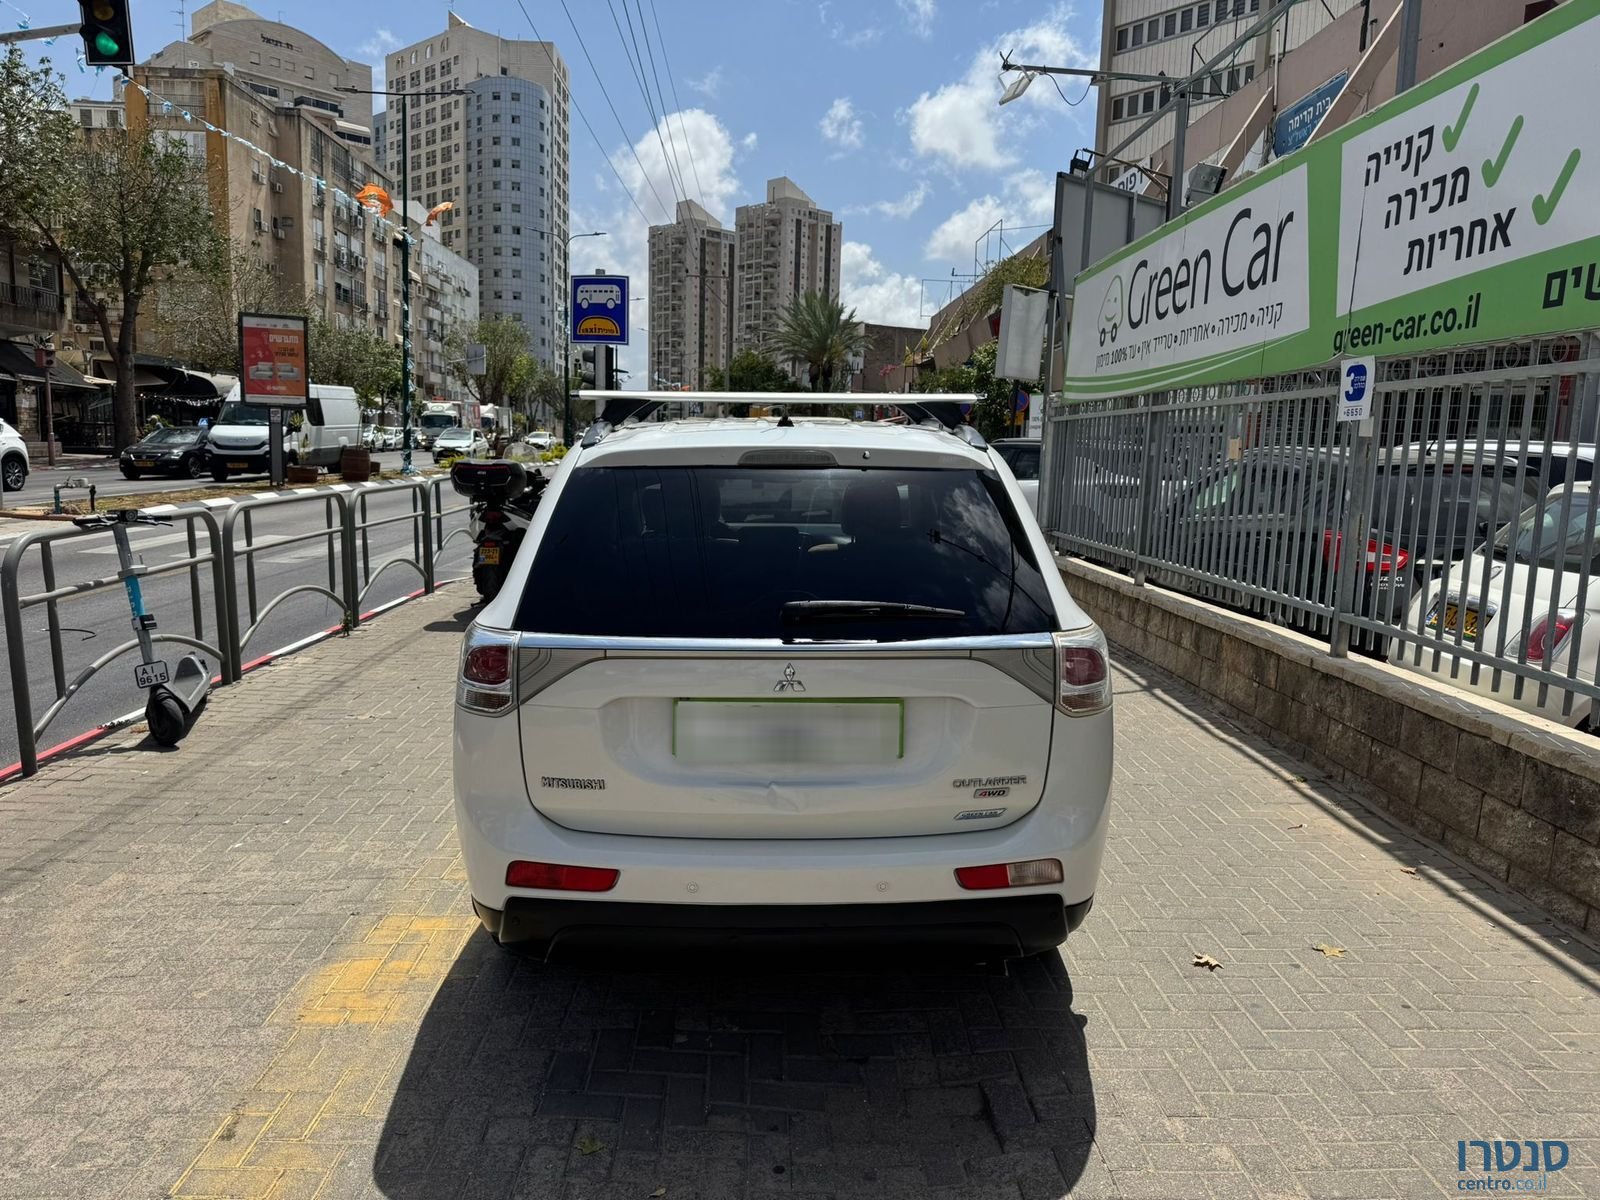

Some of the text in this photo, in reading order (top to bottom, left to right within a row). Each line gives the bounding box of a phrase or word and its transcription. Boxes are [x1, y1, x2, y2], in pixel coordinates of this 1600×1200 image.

[1288, 107, 1314, 133] קדימה
[1364, 125, 1435, 187] קנייה
[1384, 166, 1470, 229] מכירה
[1403, 207, 1517, 276] אחריות
[1127, 208, 1295, 330] Green Car
[1217, 311, 1248, 337] מכירה
[1256, 302, 1283, 330] קניה
[1153, 332, 1174, 353] טרייד
[1178, 322, 1210, 347] אחריות
[1110, 346, 1128, 365] 100%
[1128, 344, 1137, 360] עד
[1141, 338, 1152, 360] אין
[140, 672, 167, 686] 9615
[541, 776, 606, 790] MITSUBISHI
[952, 775, 1027, 788] OUTLANDER
[979, 789, 1006, 798] 4WD
